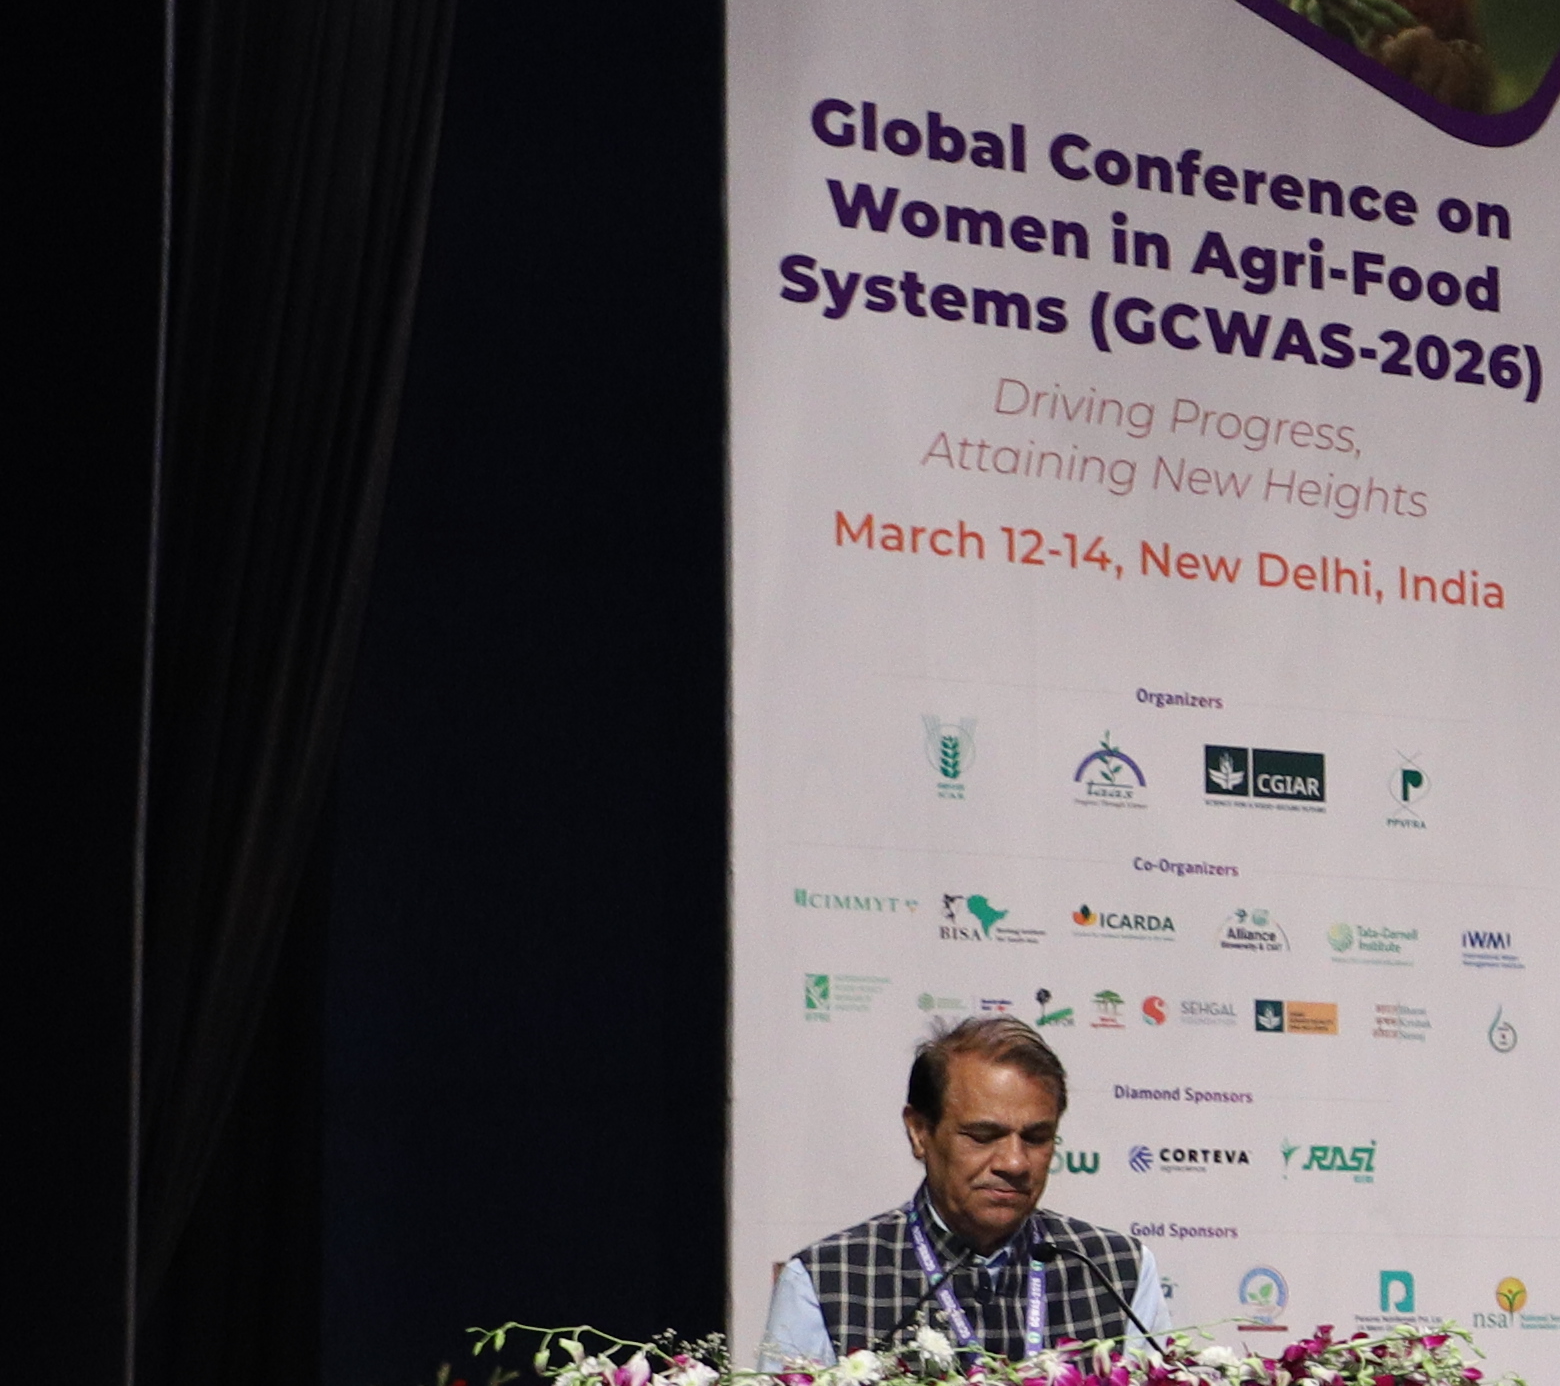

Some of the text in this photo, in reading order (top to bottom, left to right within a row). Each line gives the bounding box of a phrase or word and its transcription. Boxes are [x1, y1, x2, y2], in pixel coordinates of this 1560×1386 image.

[810, 97, 1511, 241] Global Conference on
[826, 178, 1500, 313] Women in Agri-Food
[779, 253, 1543, 404] Systems (GCWAS-2026)
[994, 377, 1362, 459] Driving Progress,
[921, 431, 1428, 521] Attaining New Heights
[835, 510, 1505, 610] March 12-14, New Delhi, India
[1135, 687, 1224, 710] Organizers
[1257, 772, 1321, 797] CGIAR
[1132, 855, 1239, 878] Co-Organizers
[810, 894, 899, 913] CIMMYT
[939, 926, 981, 942] BISA
[1100, 913, 1175, 932] ICARDA
[1227, 927, 1276, 942] Alliance
[1180, 1001, 1236, 1017] SEHGAL
[1113, 1084, 1254, 1105] Diamond Sponsors
[1158, 1147, 1250, 1165] CORTEVA
[1131, 1222, 1239, 1241] Gold Sponsors
